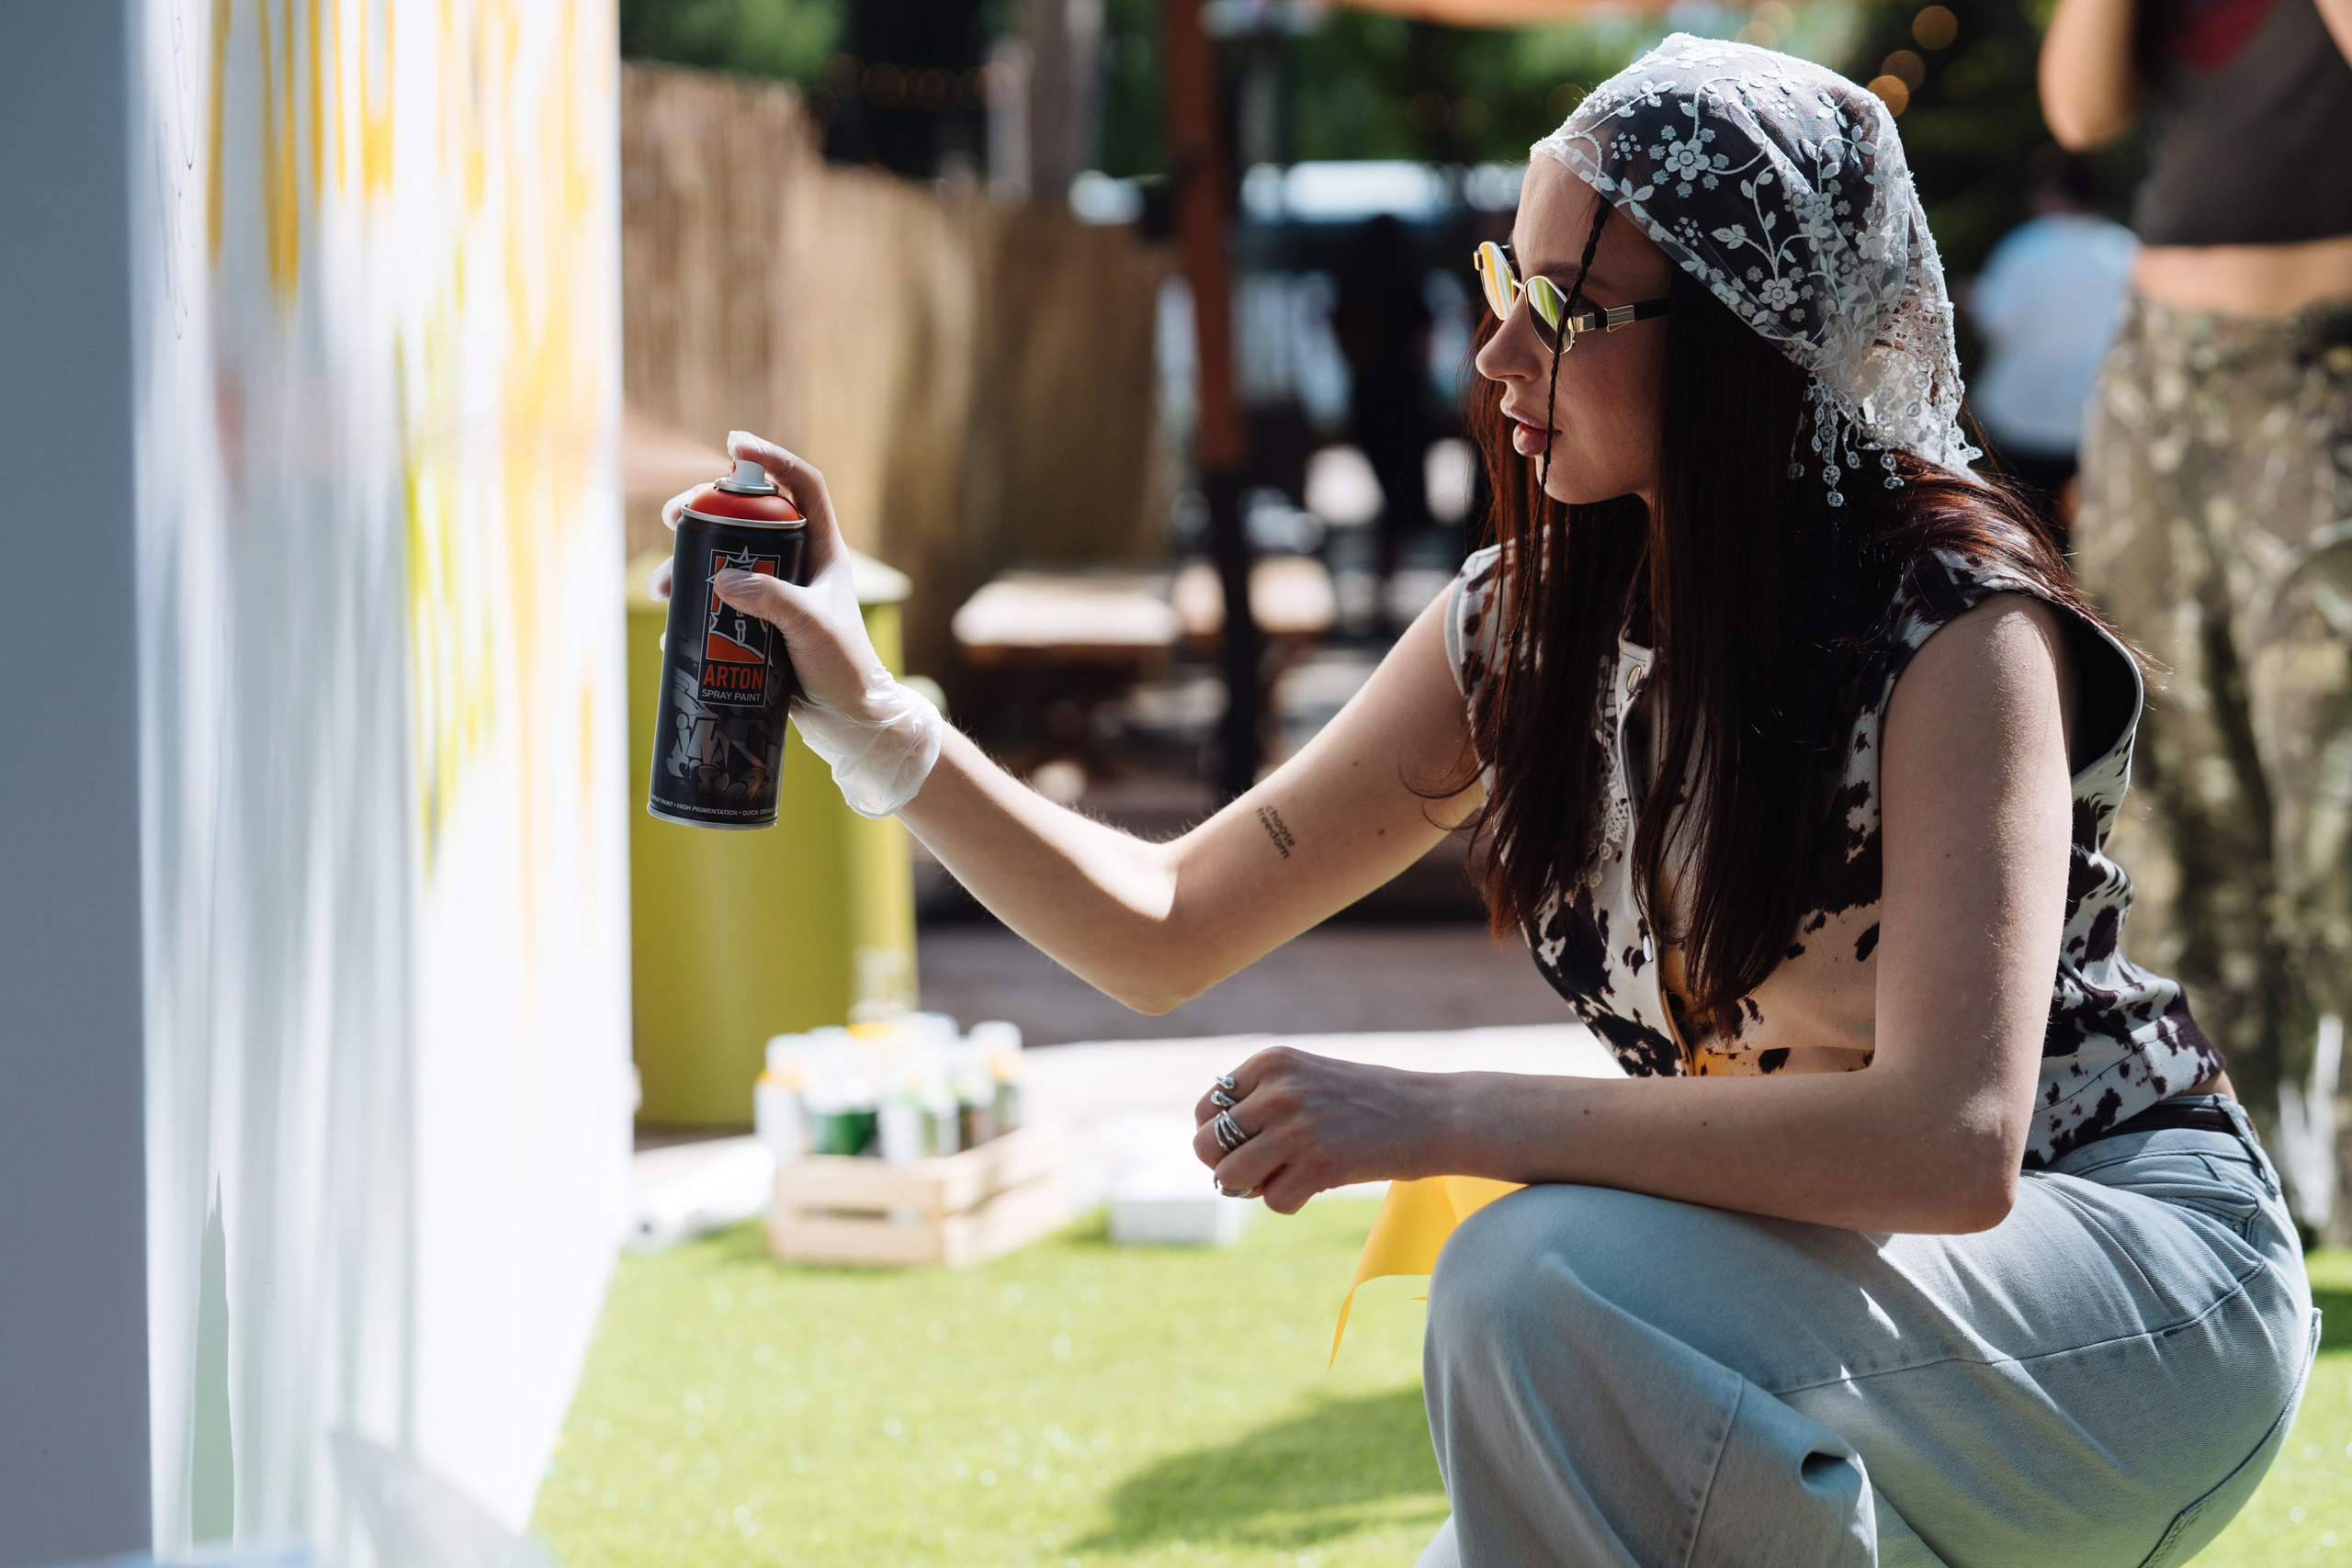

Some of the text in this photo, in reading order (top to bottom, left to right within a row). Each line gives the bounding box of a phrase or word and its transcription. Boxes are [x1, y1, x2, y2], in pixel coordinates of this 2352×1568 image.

[702, 664, 764, 690] ARTON
[701, 688, 762, 701] SPRAY PAINT
[661, 798, 673, 807] PAINT
[676, 803, 691, 811] HIGH
[692, 806, 738, 815] PIGMENTATION
[1255, 807, 1290, 859] freedom
[1265, 806, 1295, 847] choose
